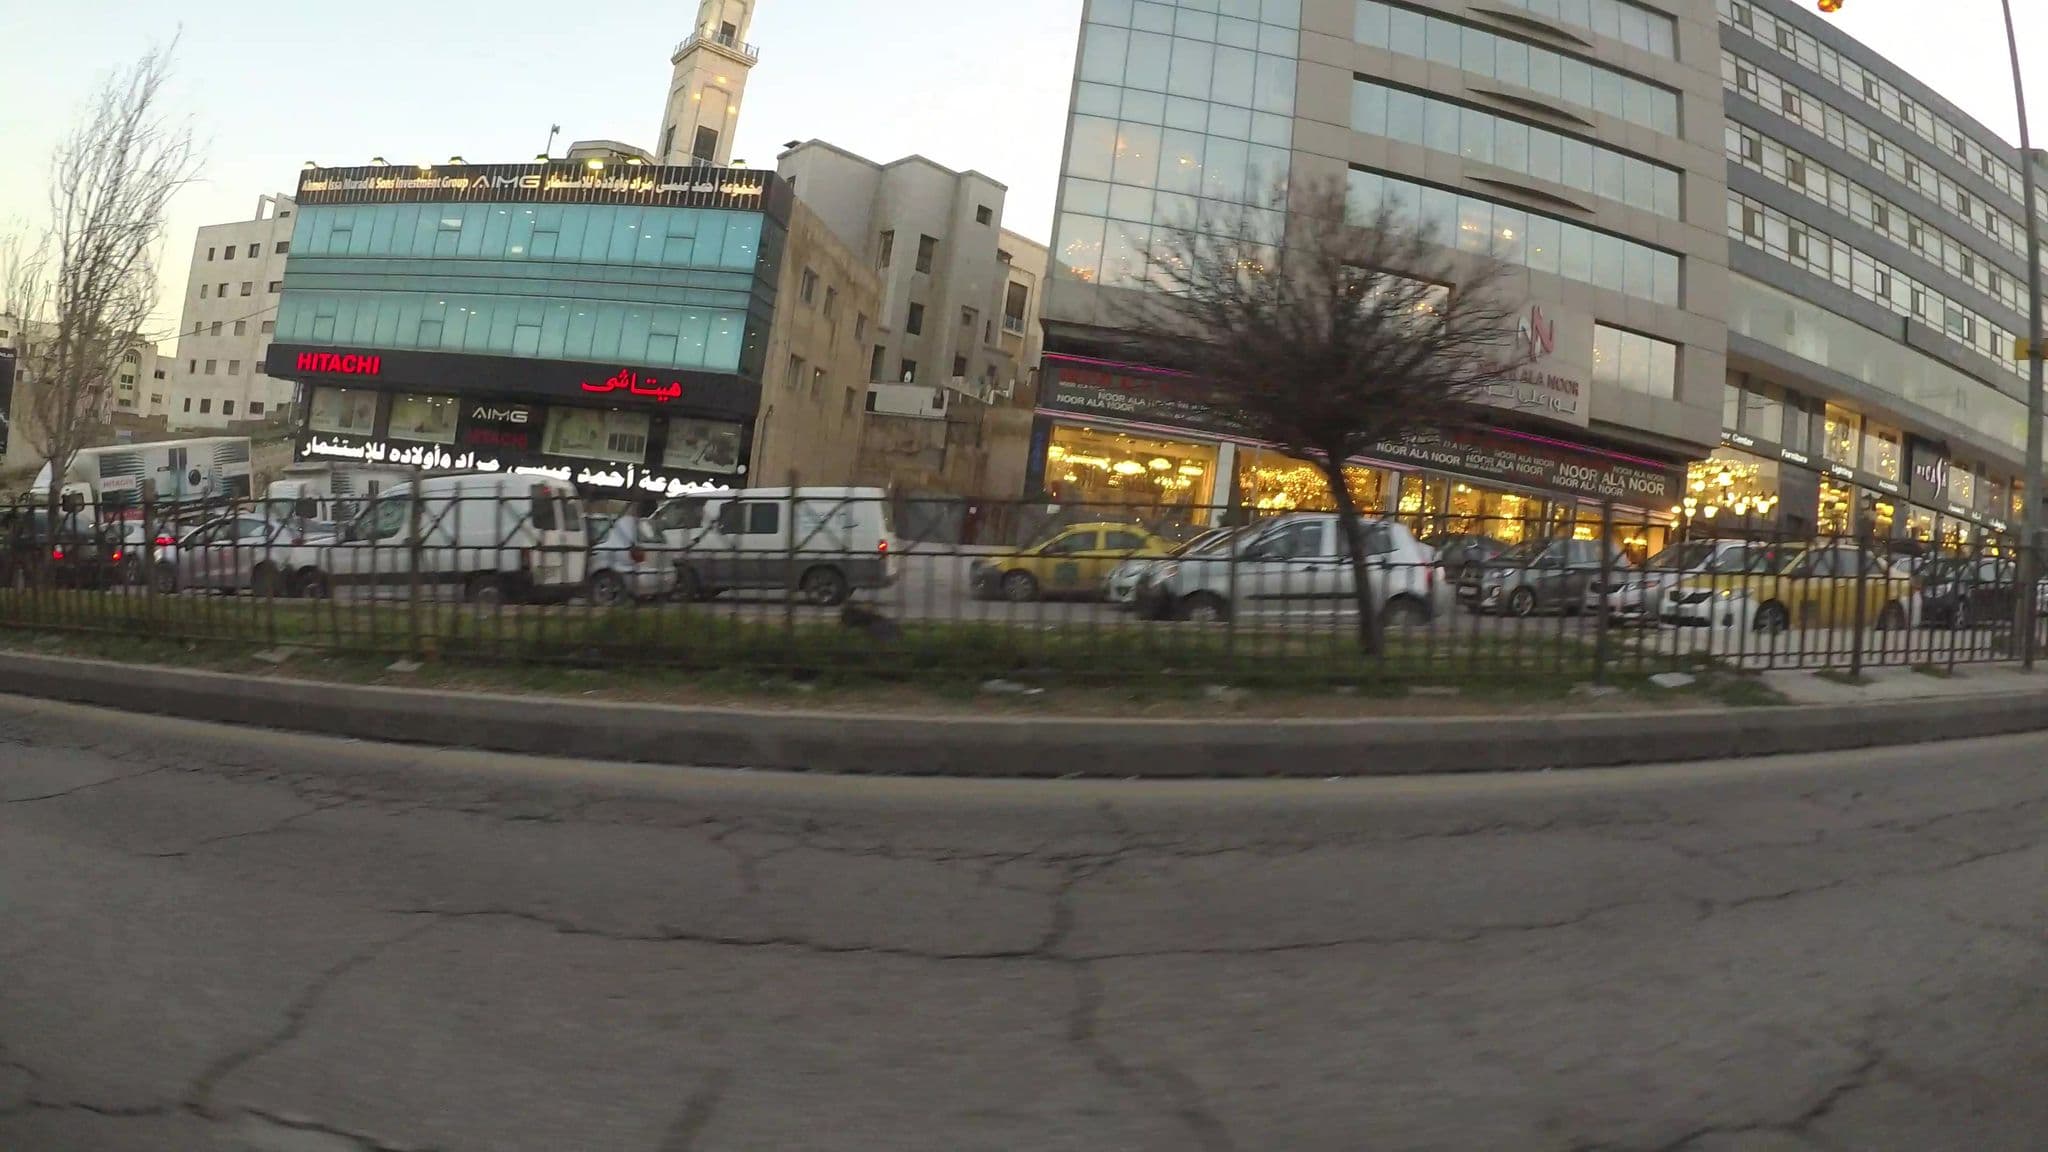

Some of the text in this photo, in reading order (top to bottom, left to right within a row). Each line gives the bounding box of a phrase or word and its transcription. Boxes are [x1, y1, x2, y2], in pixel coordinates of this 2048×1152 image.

[395, 176, 441, 189] Investment
[441, 175, 469, 192] Group
[472, 175, 542, 189] AIMG
[297, 351, 381, 376] HITACHI
[1056, 393, 1085, 406] NOOR
[1086, 398, 1105, 408] ALA
[1106, 401, 1135, 413] NOOR
[1097, 391, 1126, 403] NOOR
[472, 406, 529, 423] AIMG
[1376, 441, 1461, 465] NOOR ALA NOOR
[1465, 454, 1544, 476] NOOR ALA NOOR
[1552, 474, 1579, 489] NOOR
[1559, 462, 1665, 497] NOOR ALA NOOR
